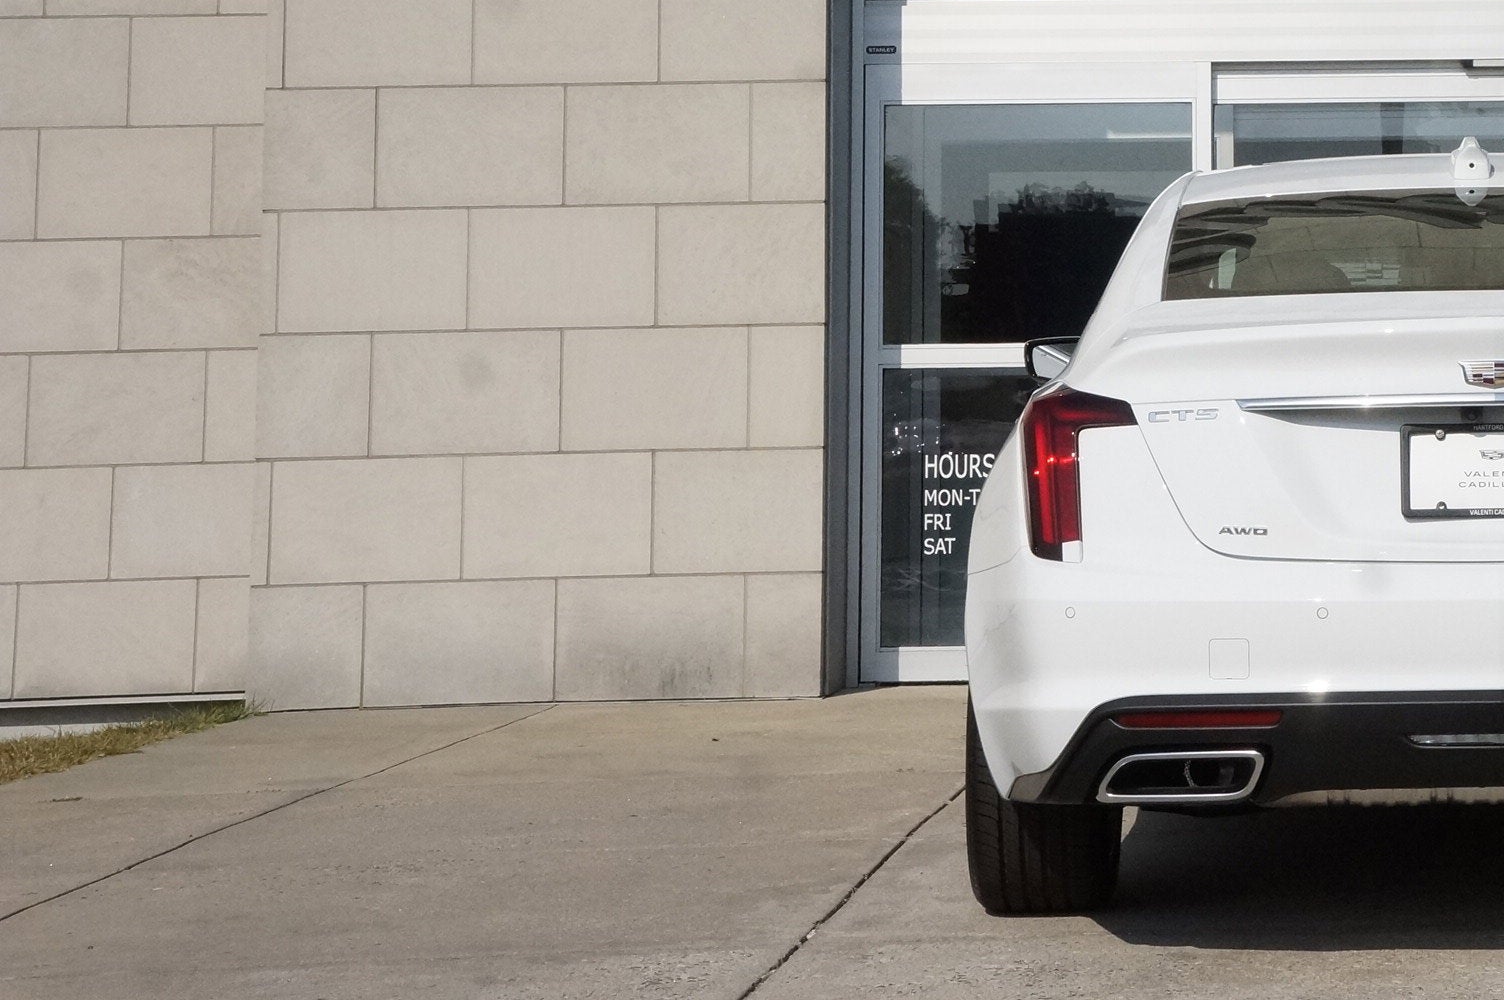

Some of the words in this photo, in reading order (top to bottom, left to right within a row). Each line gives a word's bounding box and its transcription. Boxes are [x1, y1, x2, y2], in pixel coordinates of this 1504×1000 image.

[924, 453, 996, 479] HOURS
[1469, 508, 1494, 516] VALENTI
[924, 513, 952, 531] FRI
[1218, 526, 1268, 536] AWD
[923, 537, 956, 555] SAT
